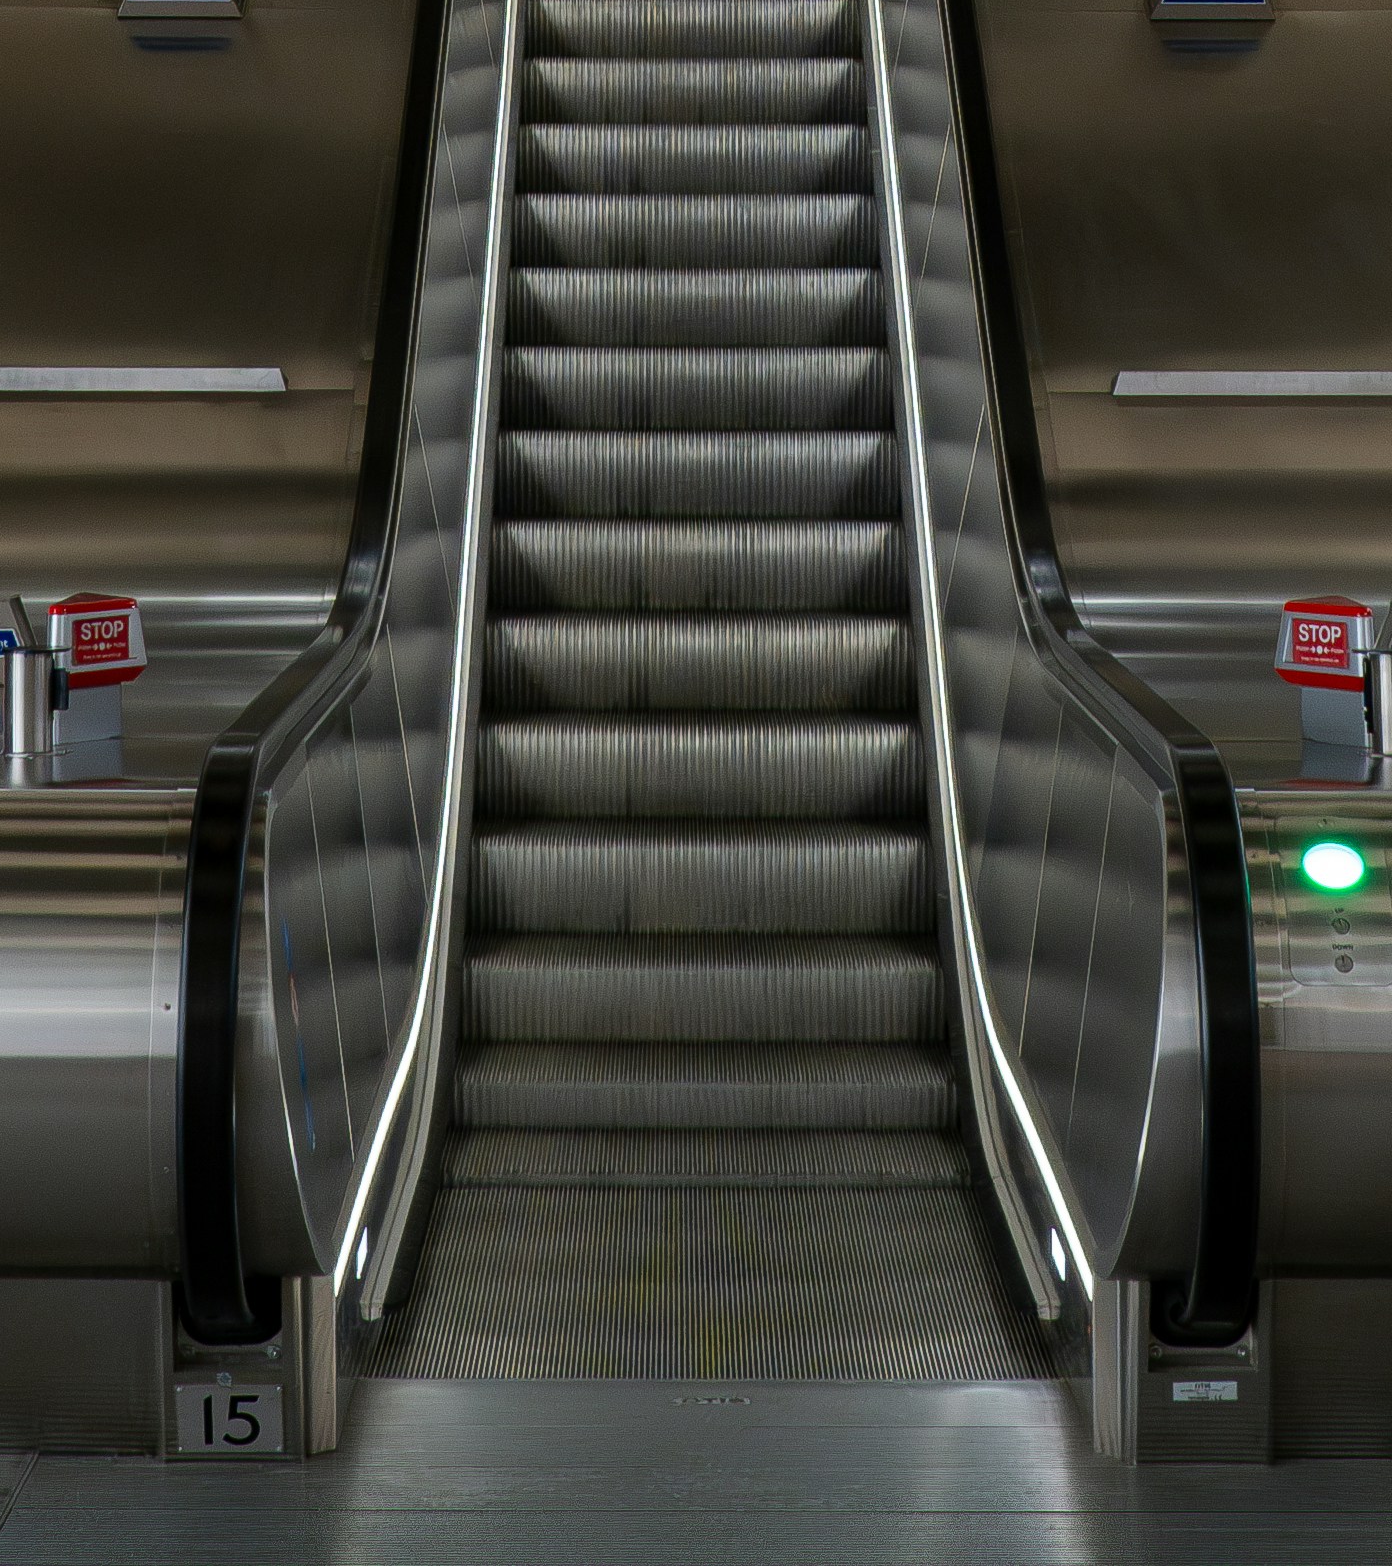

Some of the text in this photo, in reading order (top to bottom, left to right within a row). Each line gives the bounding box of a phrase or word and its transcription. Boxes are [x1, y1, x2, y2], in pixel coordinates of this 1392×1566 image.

[80, 620, 124, 641] STOP
[1298, 623, 1342, 644] STOP
[203, 1394, 261, 1446] 15
